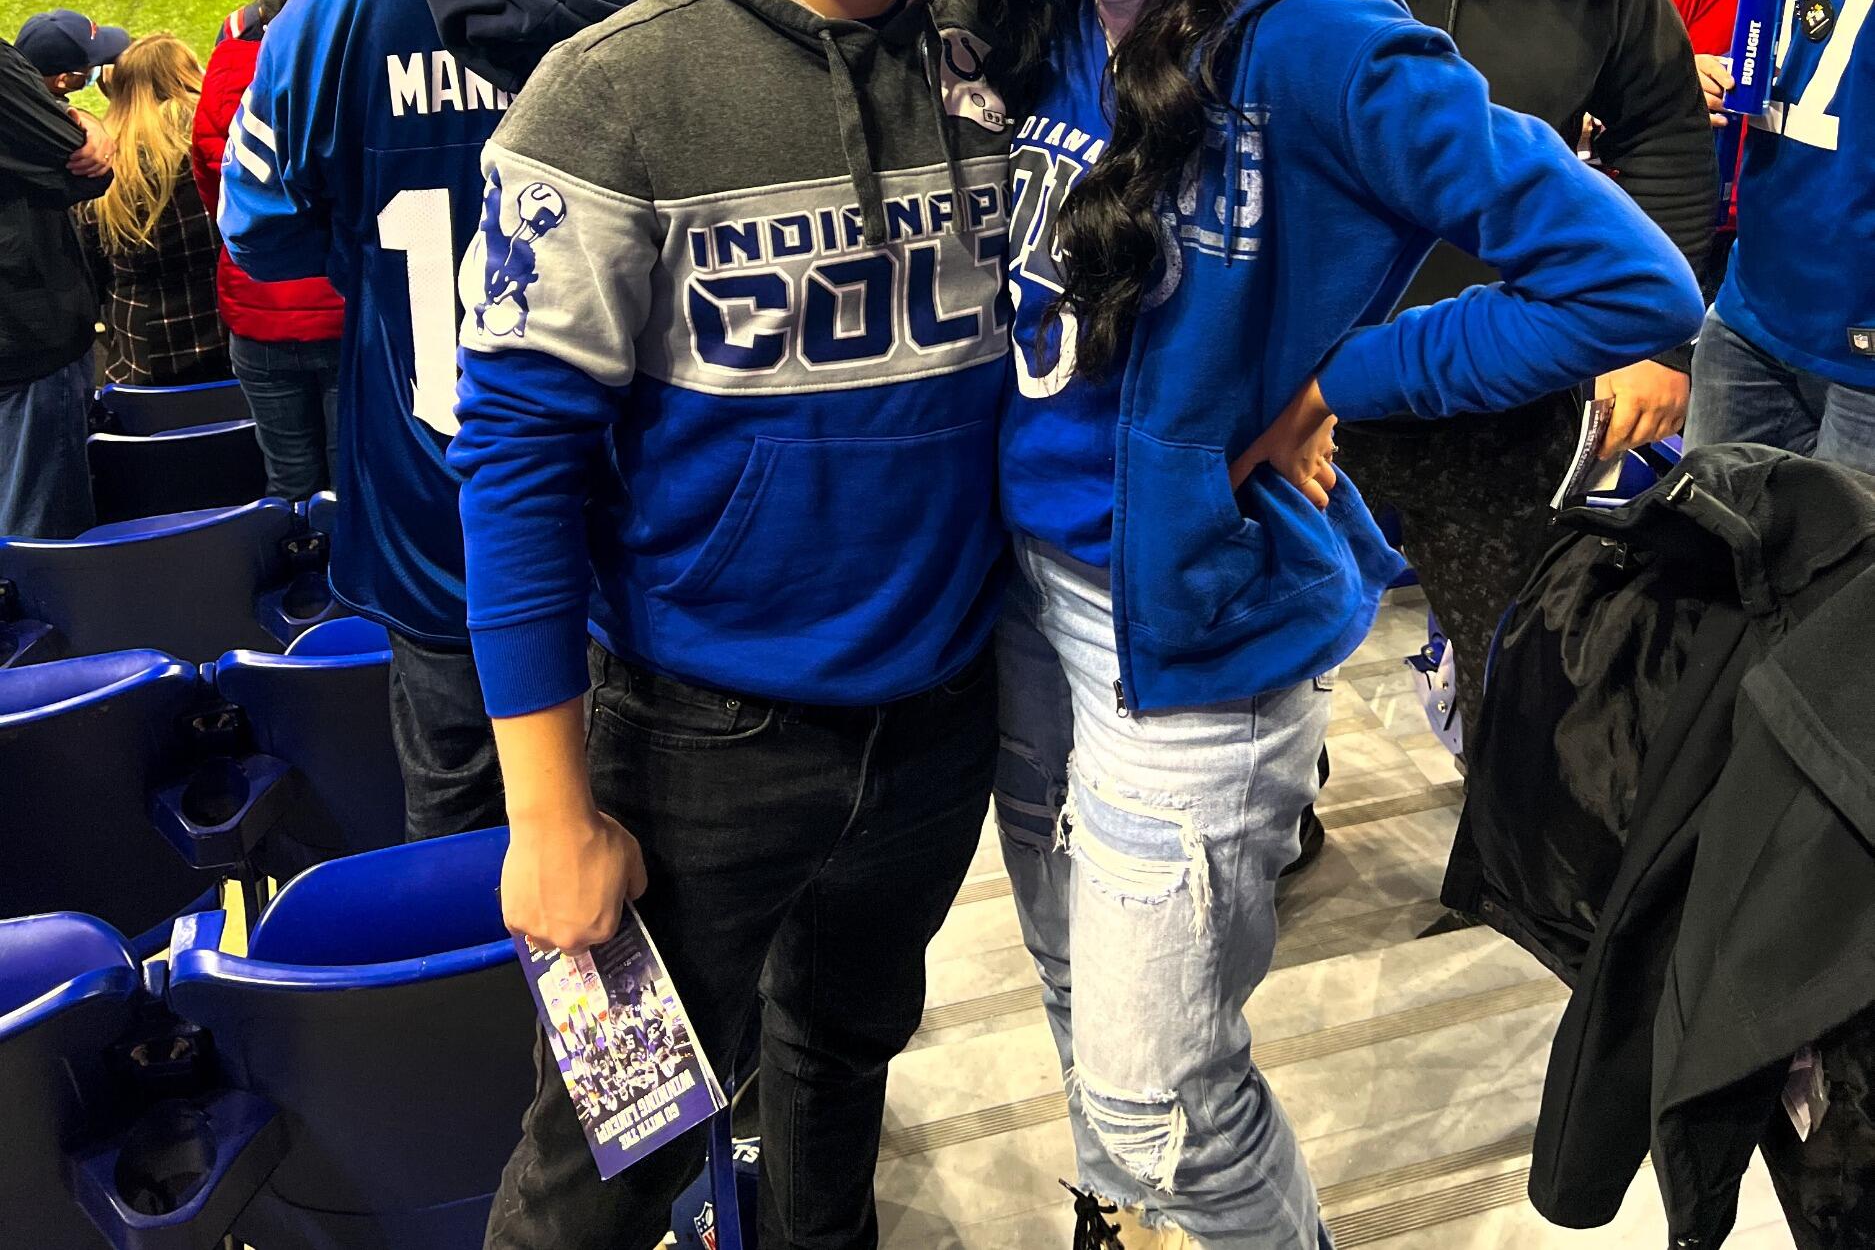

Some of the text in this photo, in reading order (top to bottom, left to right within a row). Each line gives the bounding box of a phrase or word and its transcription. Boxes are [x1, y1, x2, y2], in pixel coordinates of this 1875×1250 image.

[1741, 20, 1761, 86] BUD LIGHT
[687, 180, 1010, 272] INDIANAP
[594, 1068, 696, 1145] WINNING LINEUP!
